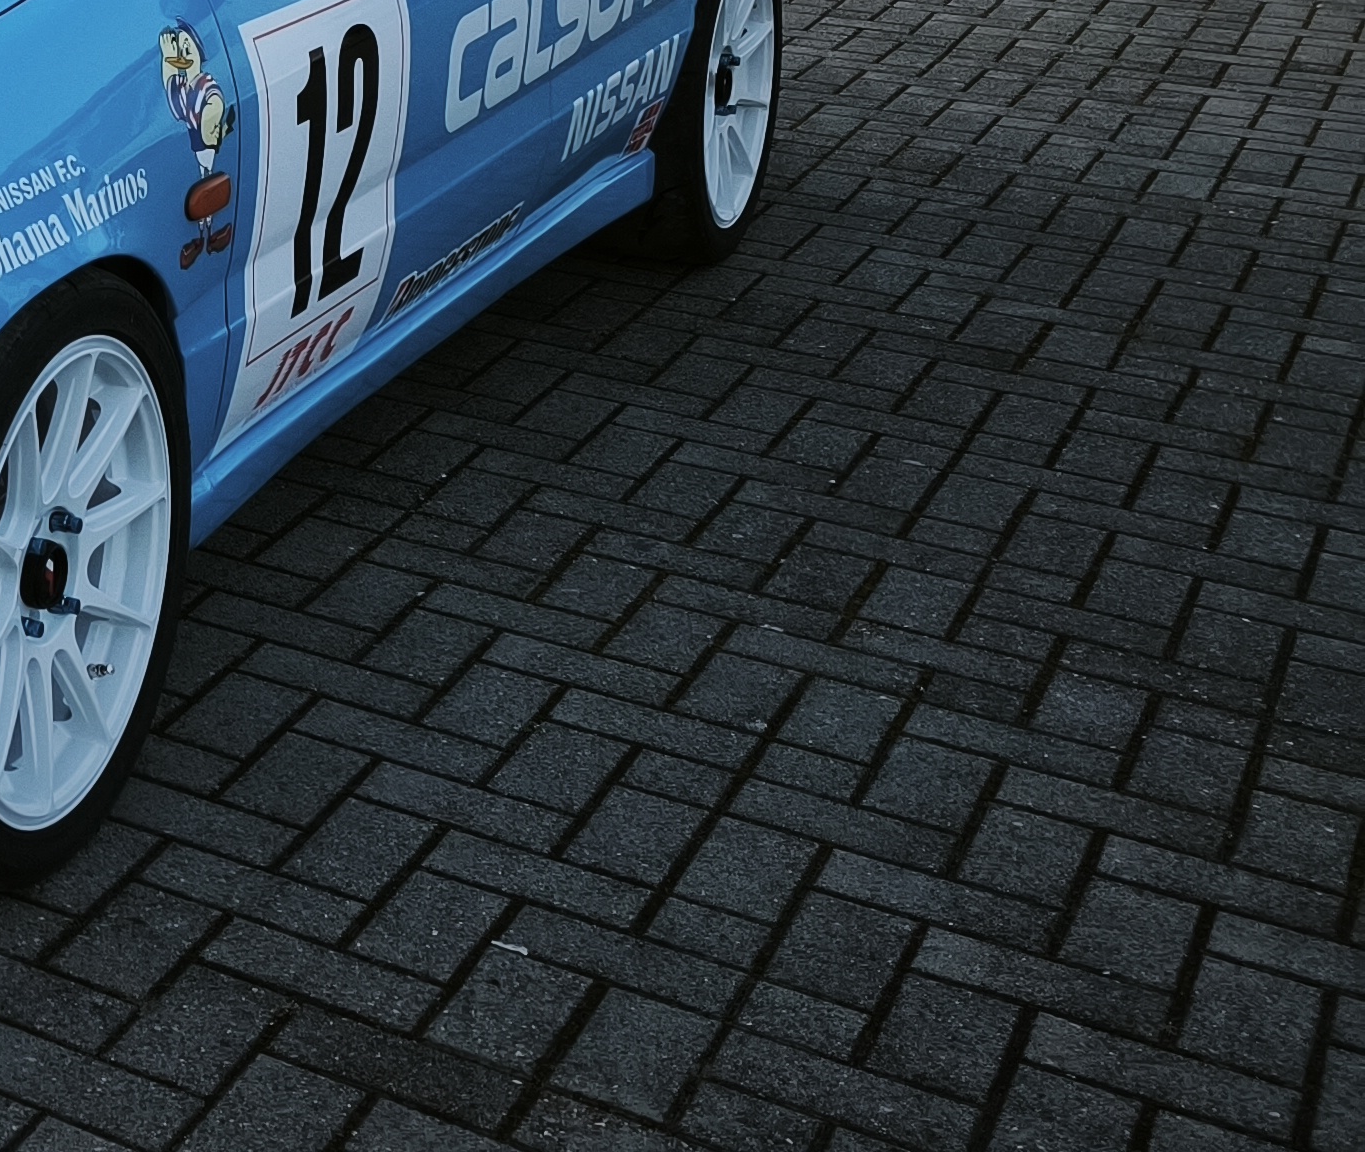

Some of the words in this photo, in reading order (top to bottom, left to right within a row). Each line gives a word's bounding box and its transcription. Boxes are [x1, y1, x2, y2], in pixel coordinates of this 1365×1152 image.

[560, 33, 680, 163] NISSAN
[53, 154, 86, 184] F.C.
[61, 167, 149, 237] Marinos
[290, 23, 381, 321] 12
